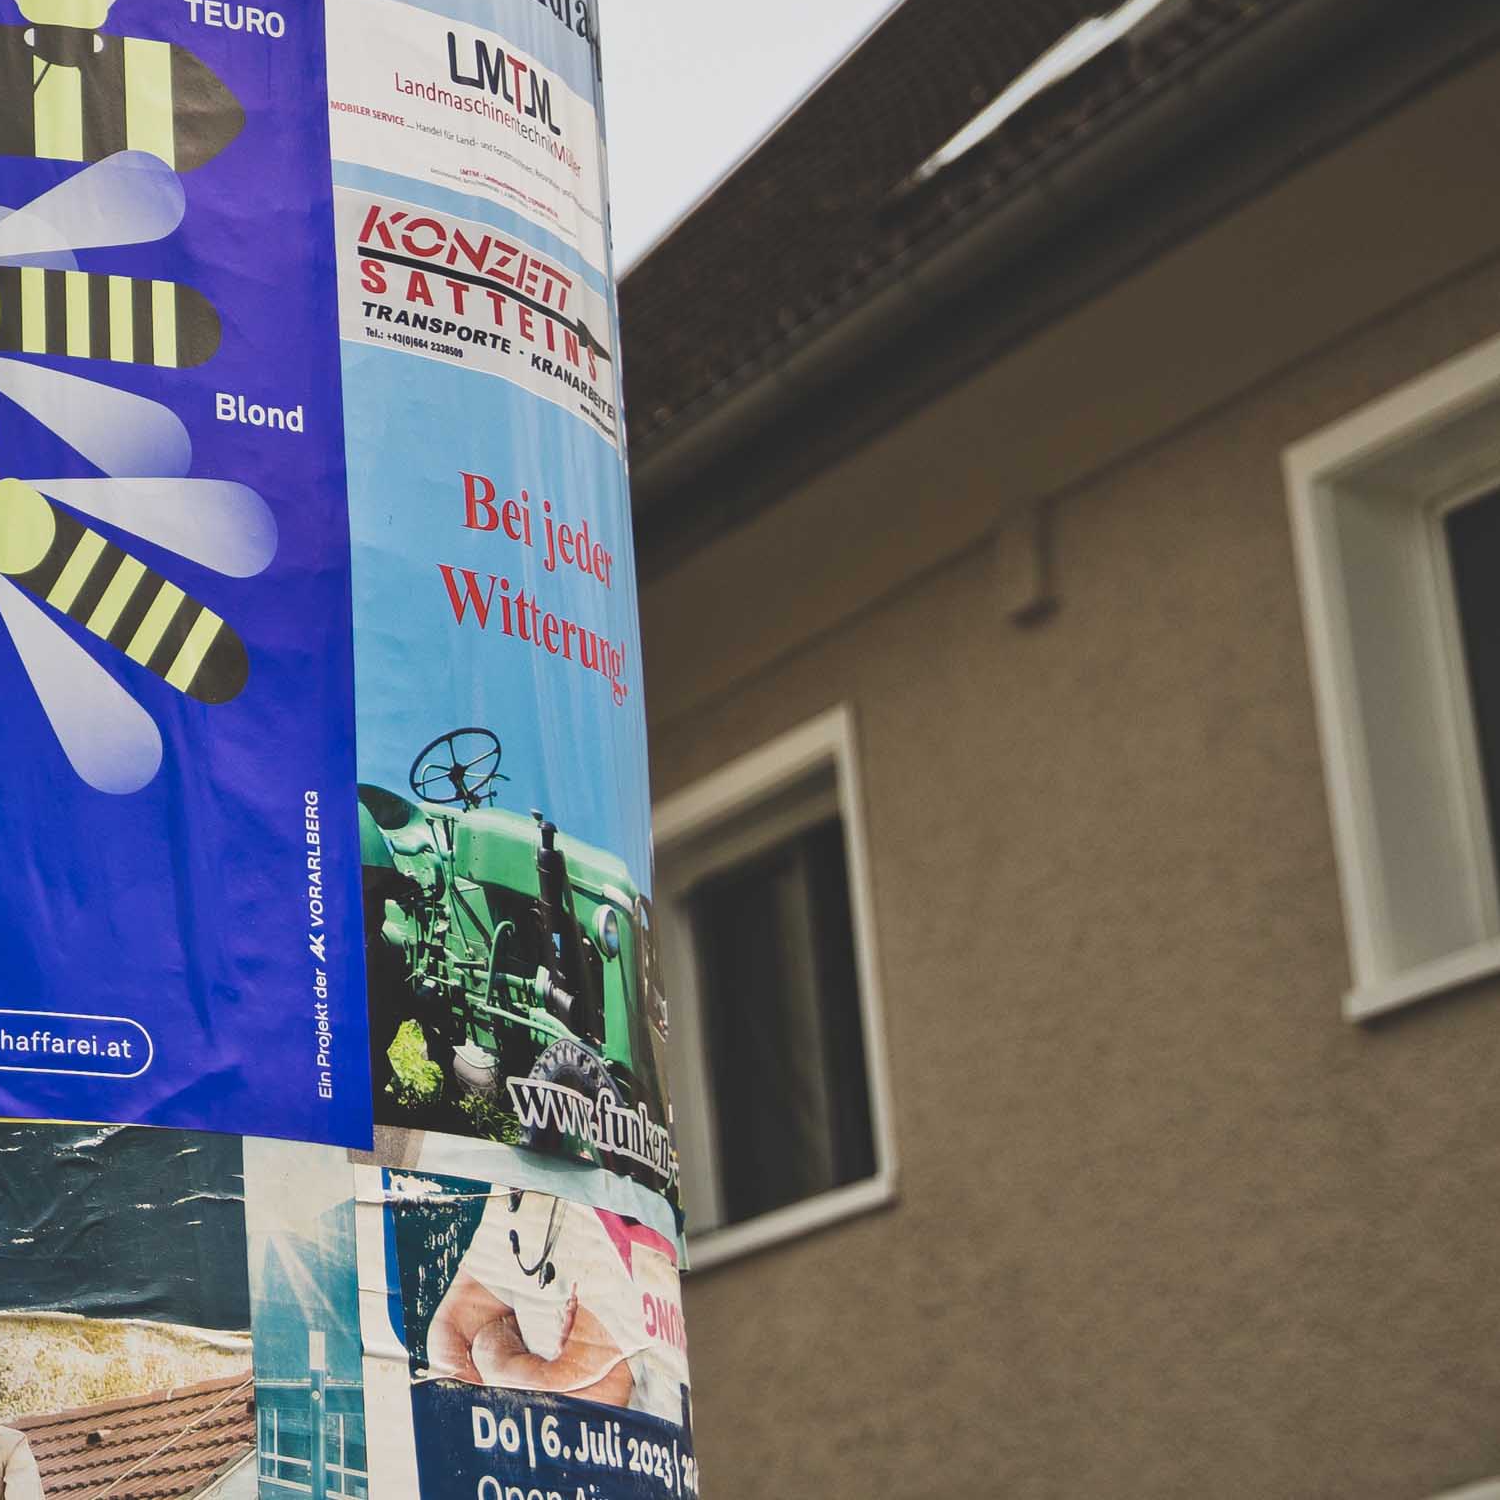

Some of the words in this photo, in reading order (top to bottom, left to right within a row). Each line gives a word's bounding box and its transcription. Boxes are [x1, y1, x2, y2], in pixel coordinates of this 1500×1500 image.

[330, 100, 371, 118] MOBILER
[372, 109, 406, 127] SERVICE
[357, 204, 573, 312] KONZETT
[360, 258, 597, 382] SATTEINS
[361, 301, 512, 355] TRANSPORTE
[216, 392, 304, 433] Blond
[457, 469, 534, 548] Bei
[543, 499, 614, 591] jeder
[436, 563, 629, 707] Witterung!
[304, 790, 325, 928] VORARLBERG
[312, 968, 329, 999] der
[315, 1003, 333, 1068] Projekt
[318, 1070, 332, 1100] Ein
[471, 1405, 520, 1453] Do
[540, 1414, 571, 1460] 6.
[574, 1420, 623, 1468] Juli
[627, 1437, 673, 1489] 2023
